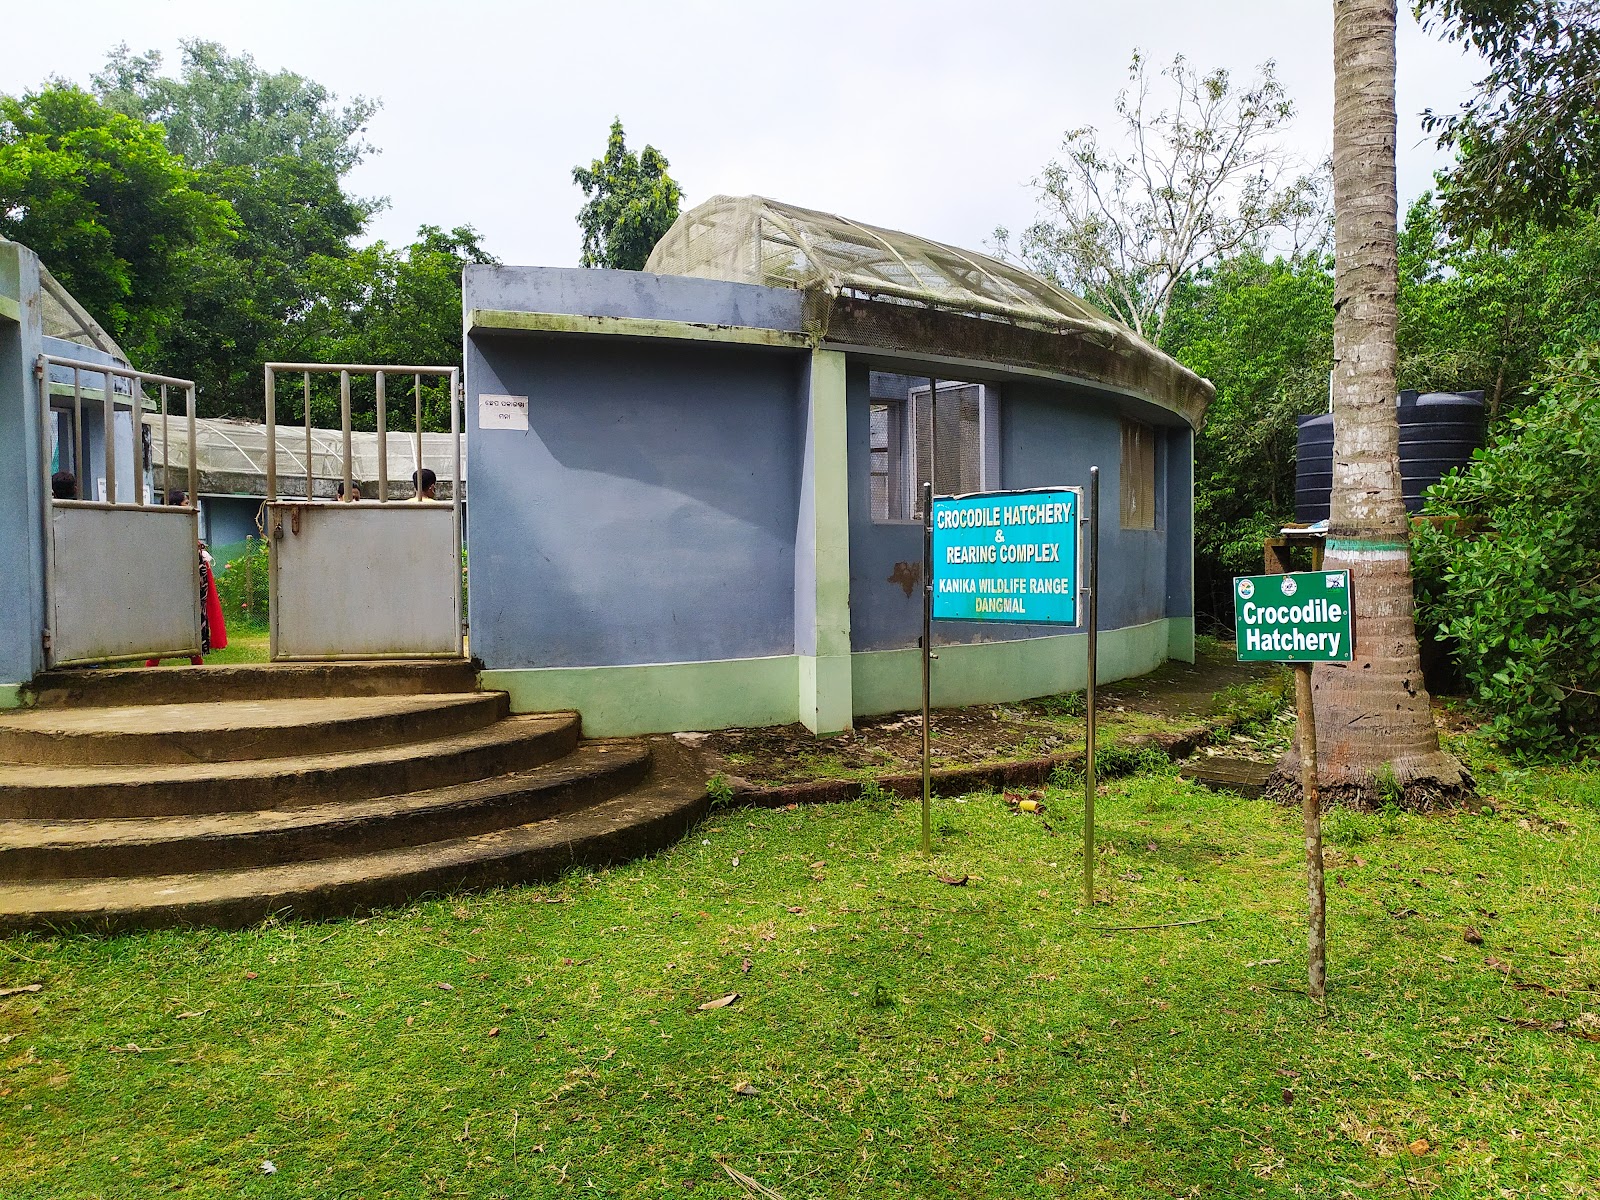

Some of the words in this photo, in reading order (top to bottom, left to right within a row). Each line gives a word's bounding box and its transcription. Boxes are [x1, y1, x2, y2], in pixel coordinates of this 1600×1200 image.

[937, 507, 1001, 530] CROCODILE
[1003, 503, 1072, 526] HATCHERY
[994, 529, 1005, 543] &
[946, 545, 996, 564] REARING
[999, 543, 1059, 563] COMPLEX
[939, 578, 976, 593] KANIKA
[978, 578, 1027, 594] WILDLIFE
[1029, 578, 1068, 594] RANGE
[975, 597, 1026, 613] DANGMAL
[1243, 598, 1342, 625] Crocodile
[1246, 628, 1341, 657] Hatchery
